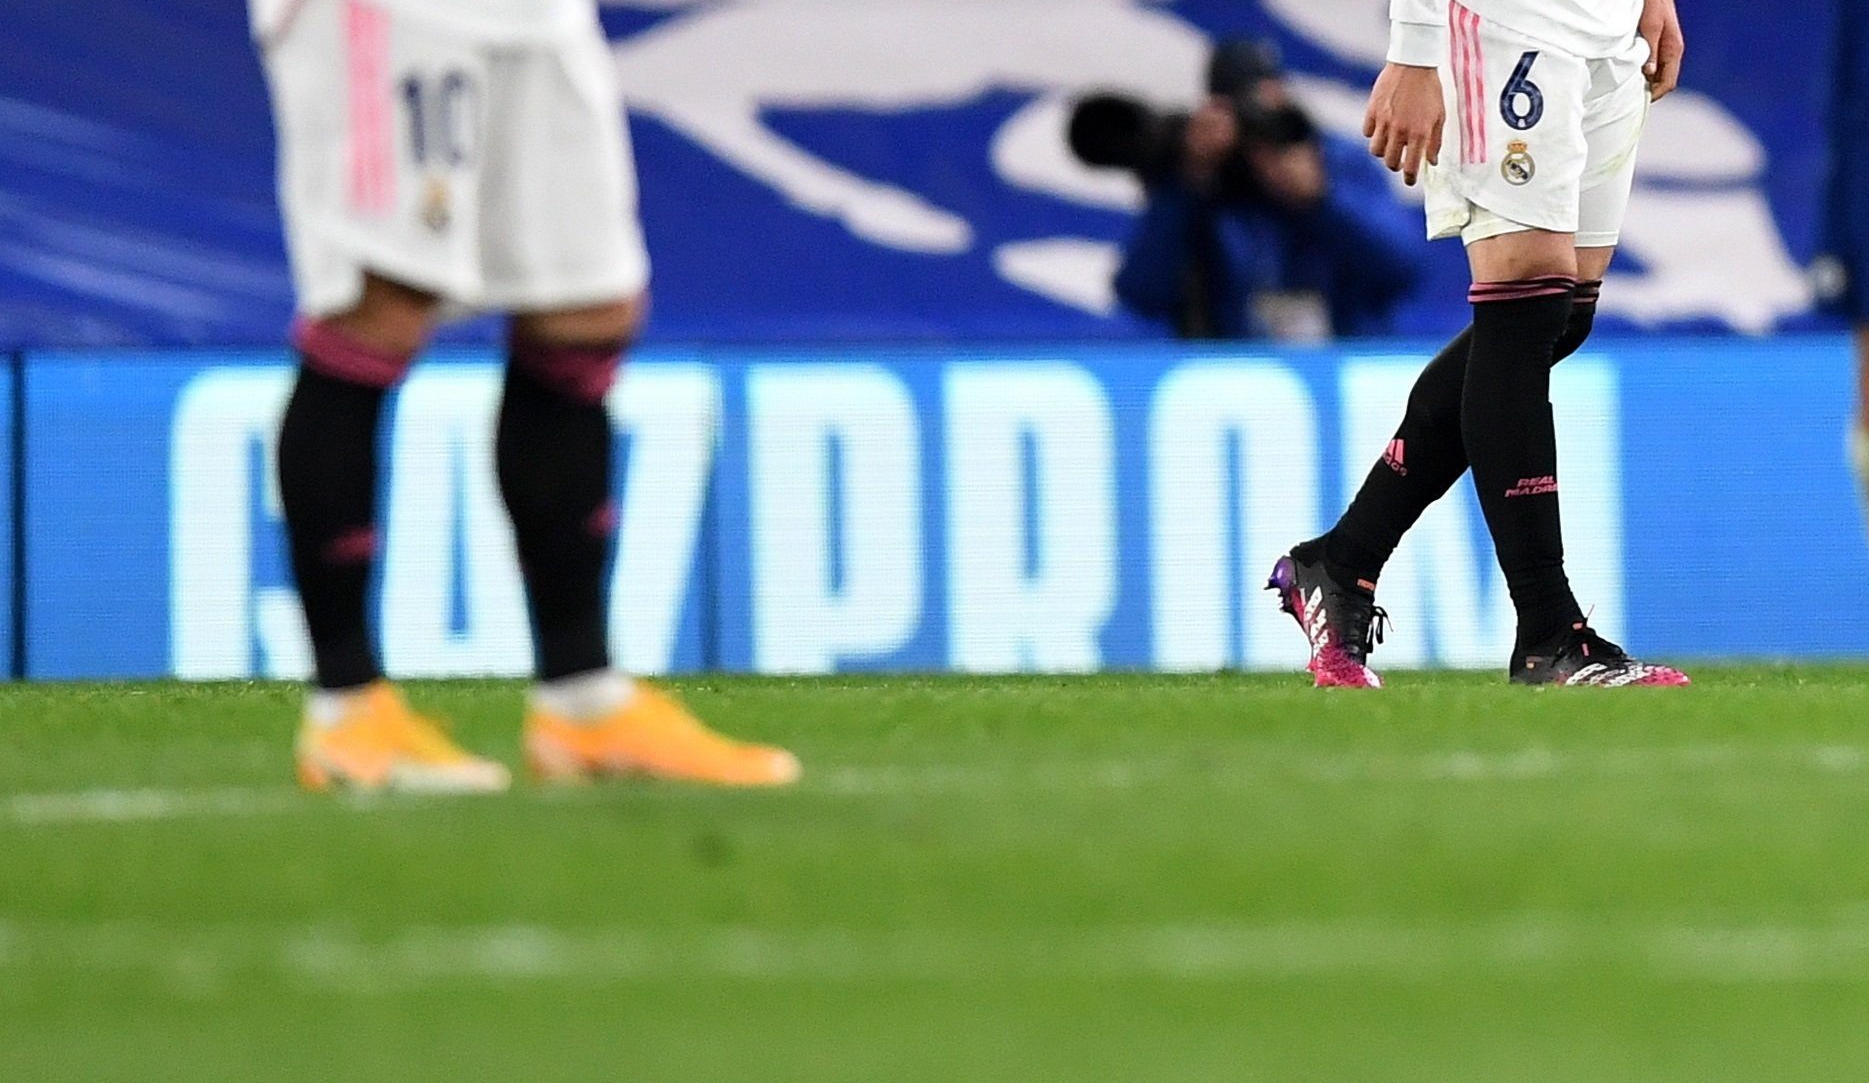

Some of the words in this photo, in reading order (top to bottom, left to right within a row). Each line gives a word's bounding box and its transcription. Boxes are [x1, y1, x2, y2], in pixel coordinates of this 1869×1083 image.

[402, 70, 478, 166] 10
[1500, 50, 1543, 130] 6
[1516, 475, 1555, 487] REAL
